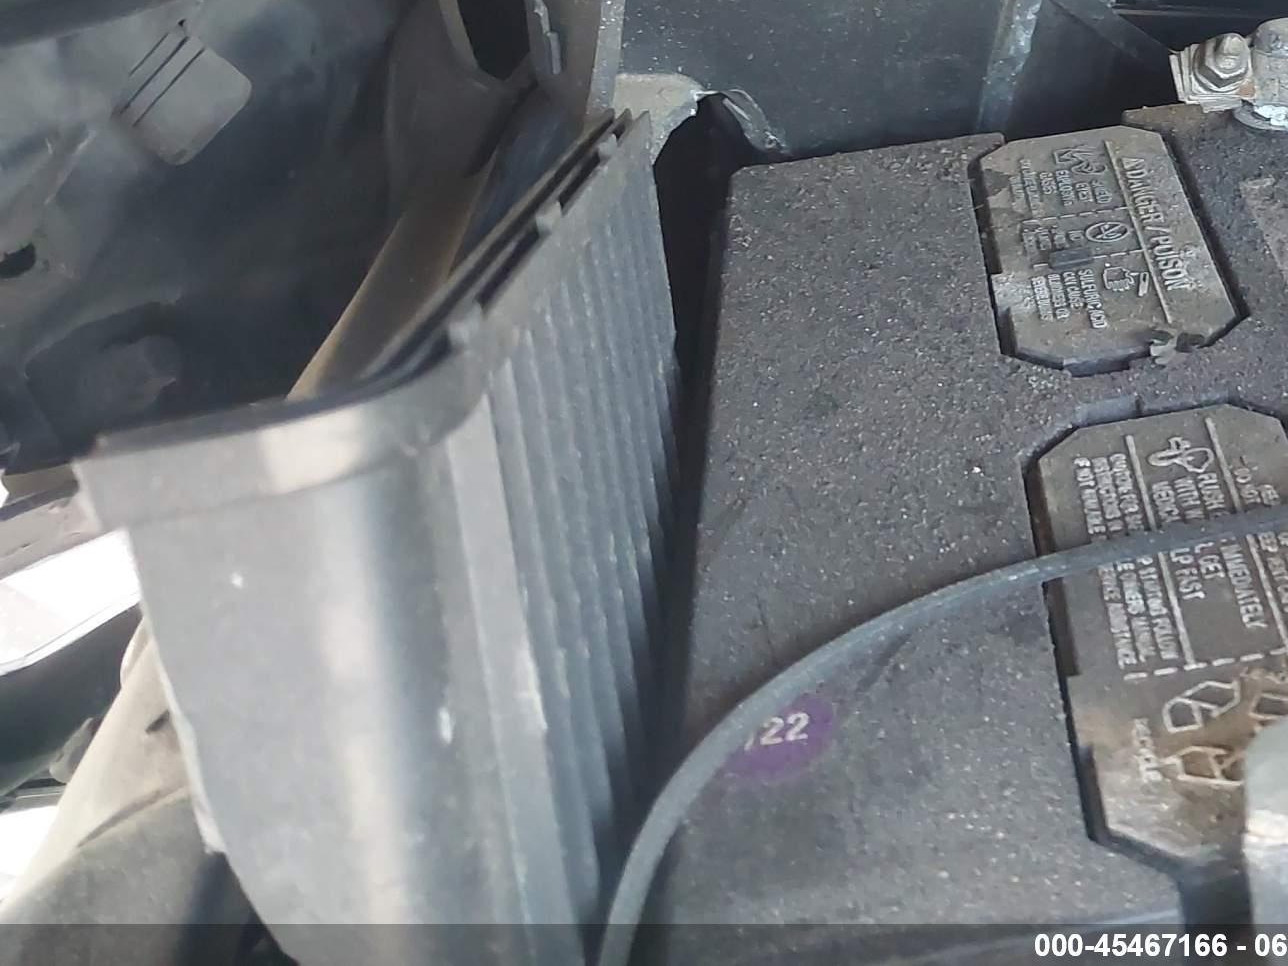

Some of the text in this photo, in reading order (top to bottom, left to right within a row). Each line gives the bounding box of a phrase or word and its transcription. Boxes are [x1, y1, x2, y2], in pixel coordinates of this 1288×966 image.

[1078, 268, 1107, 328] SULFURIC ACID
[1151, 481, 1182, 522] MEDICA
[1174, 567, 1206, 601] FAST
[1173, 476, 1202, 507] WITH
[1197, 553, 1226, 580] GET
[1196, 472, 1226, 511] FLUSH
[1219, 542, 1269, 629] IMMEDIATELY
